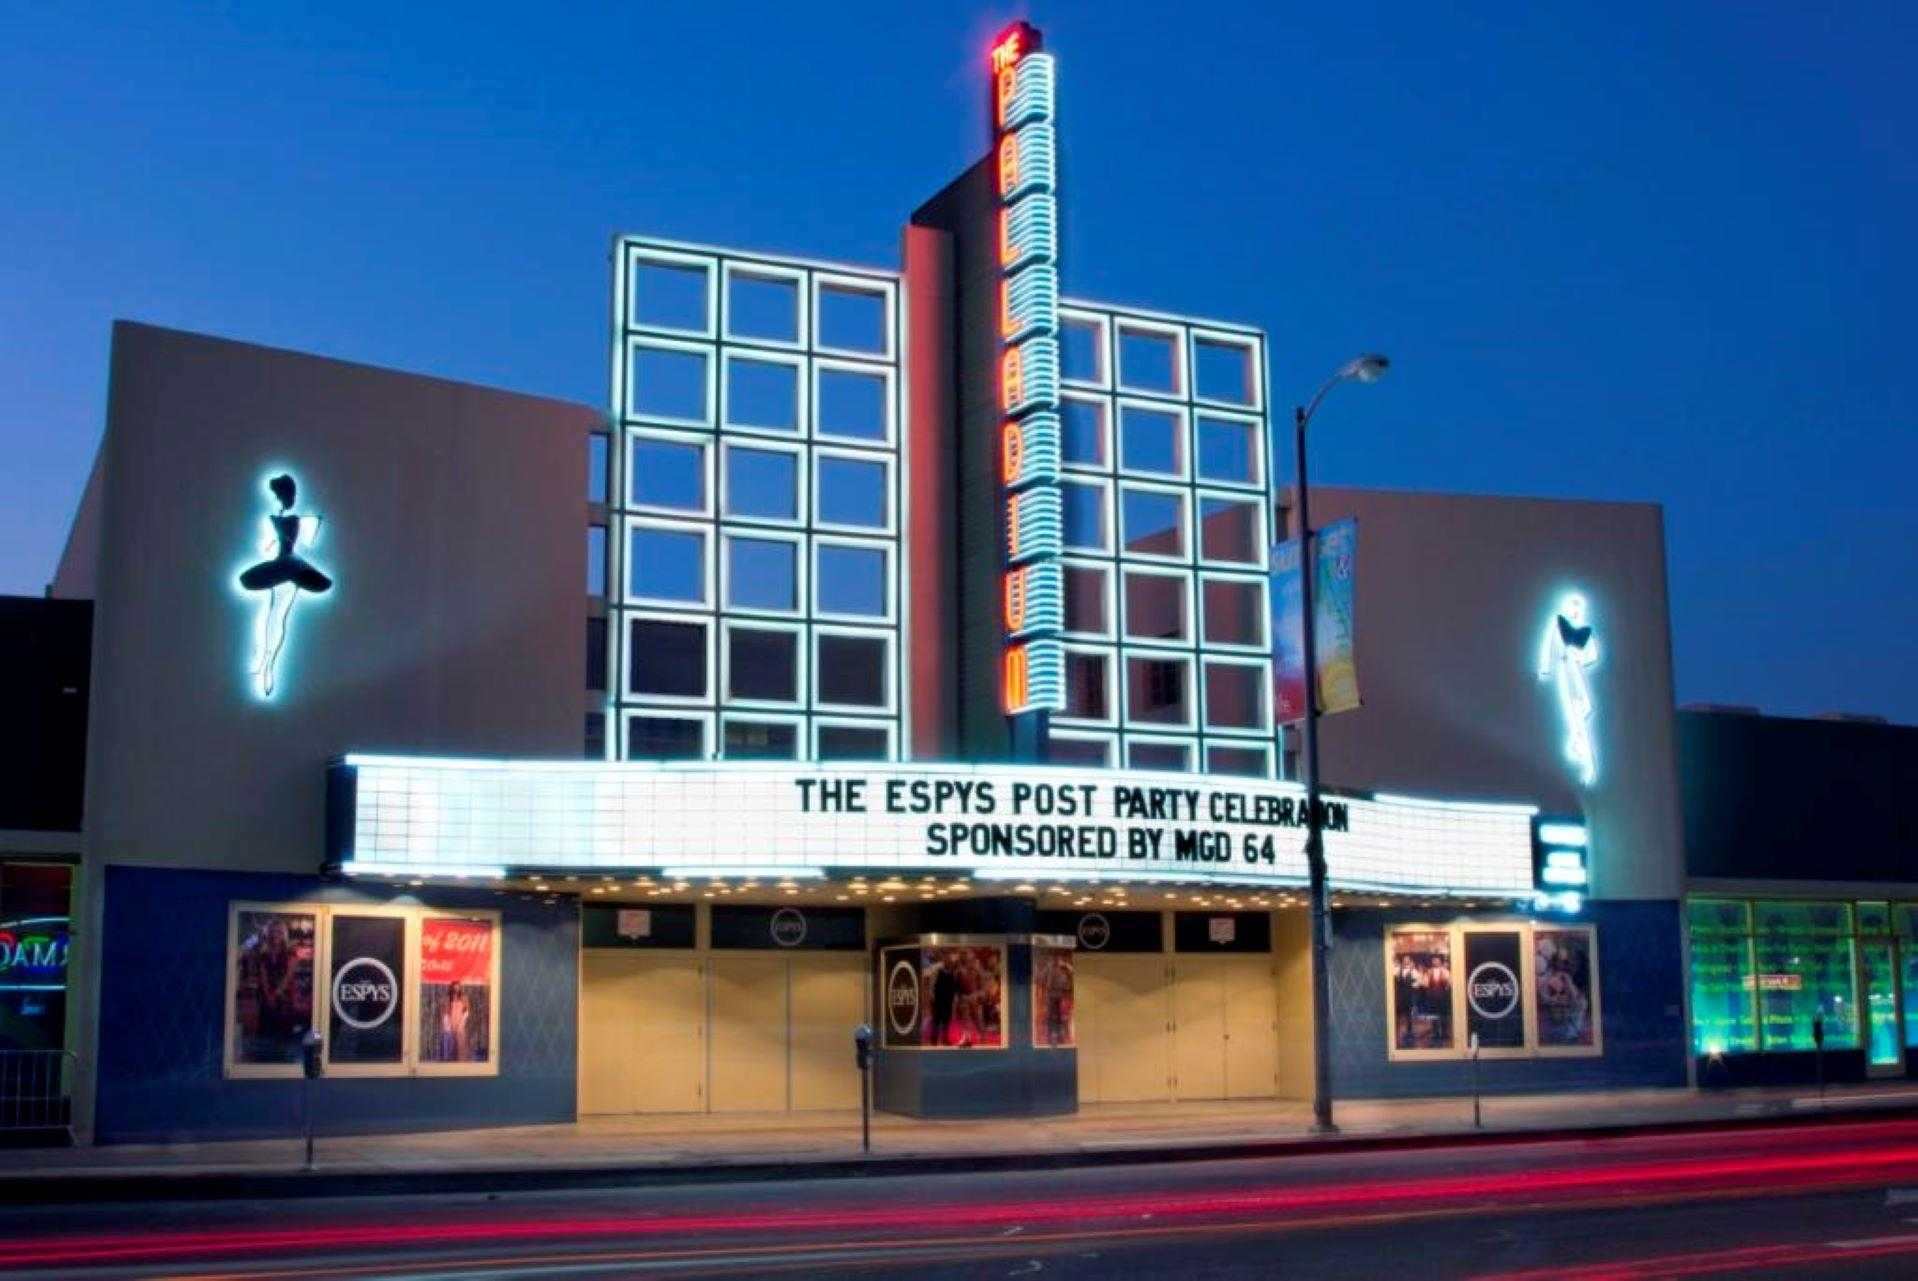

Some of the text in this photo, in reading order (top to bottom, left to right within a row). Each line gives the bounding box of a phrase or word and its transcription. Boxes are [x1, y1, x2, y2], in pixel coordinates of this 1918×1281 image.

[991, 31, 1020, 74] THE
[998, 64, 1027, 715] PALLADIUM
[795, 779, 1349, 832] THE ESPYS POST PARTY CELEBRAION
[926, 823, 1275, 864] SPONSORED BY MGD 64
[340, 983, 391, 1002] ESPYS
[1473, 983, 1514, 998] ESPYS
